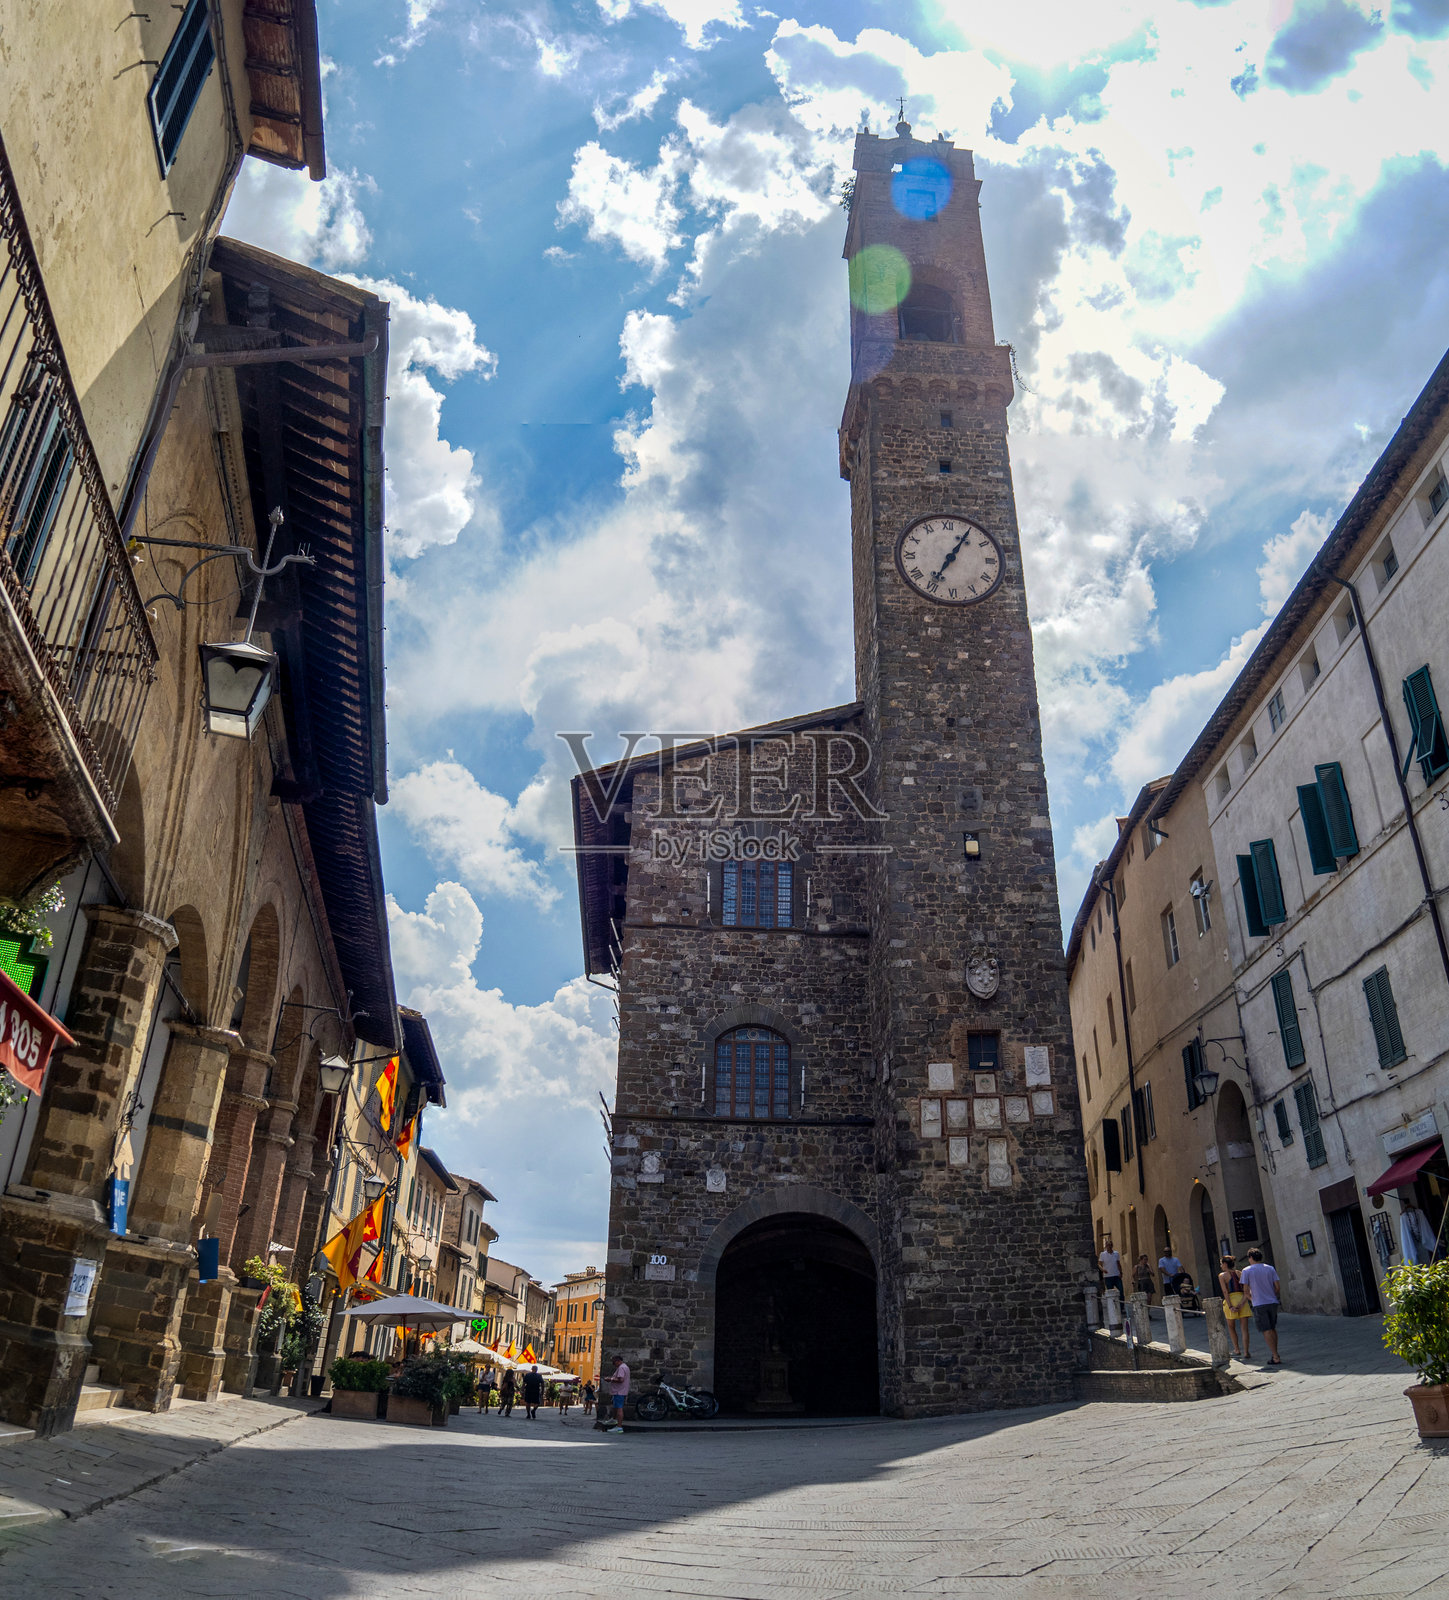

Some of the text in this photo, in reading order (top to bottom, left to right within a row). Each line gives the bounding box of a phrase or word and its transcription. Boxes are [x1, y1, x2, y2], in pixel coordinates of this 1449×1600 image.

[942, 521, 954, 531] XII
[909, 534, 920, 545] X
[948, 588, 957, 598] VI
[650, 1254, 667, 1265] 100
